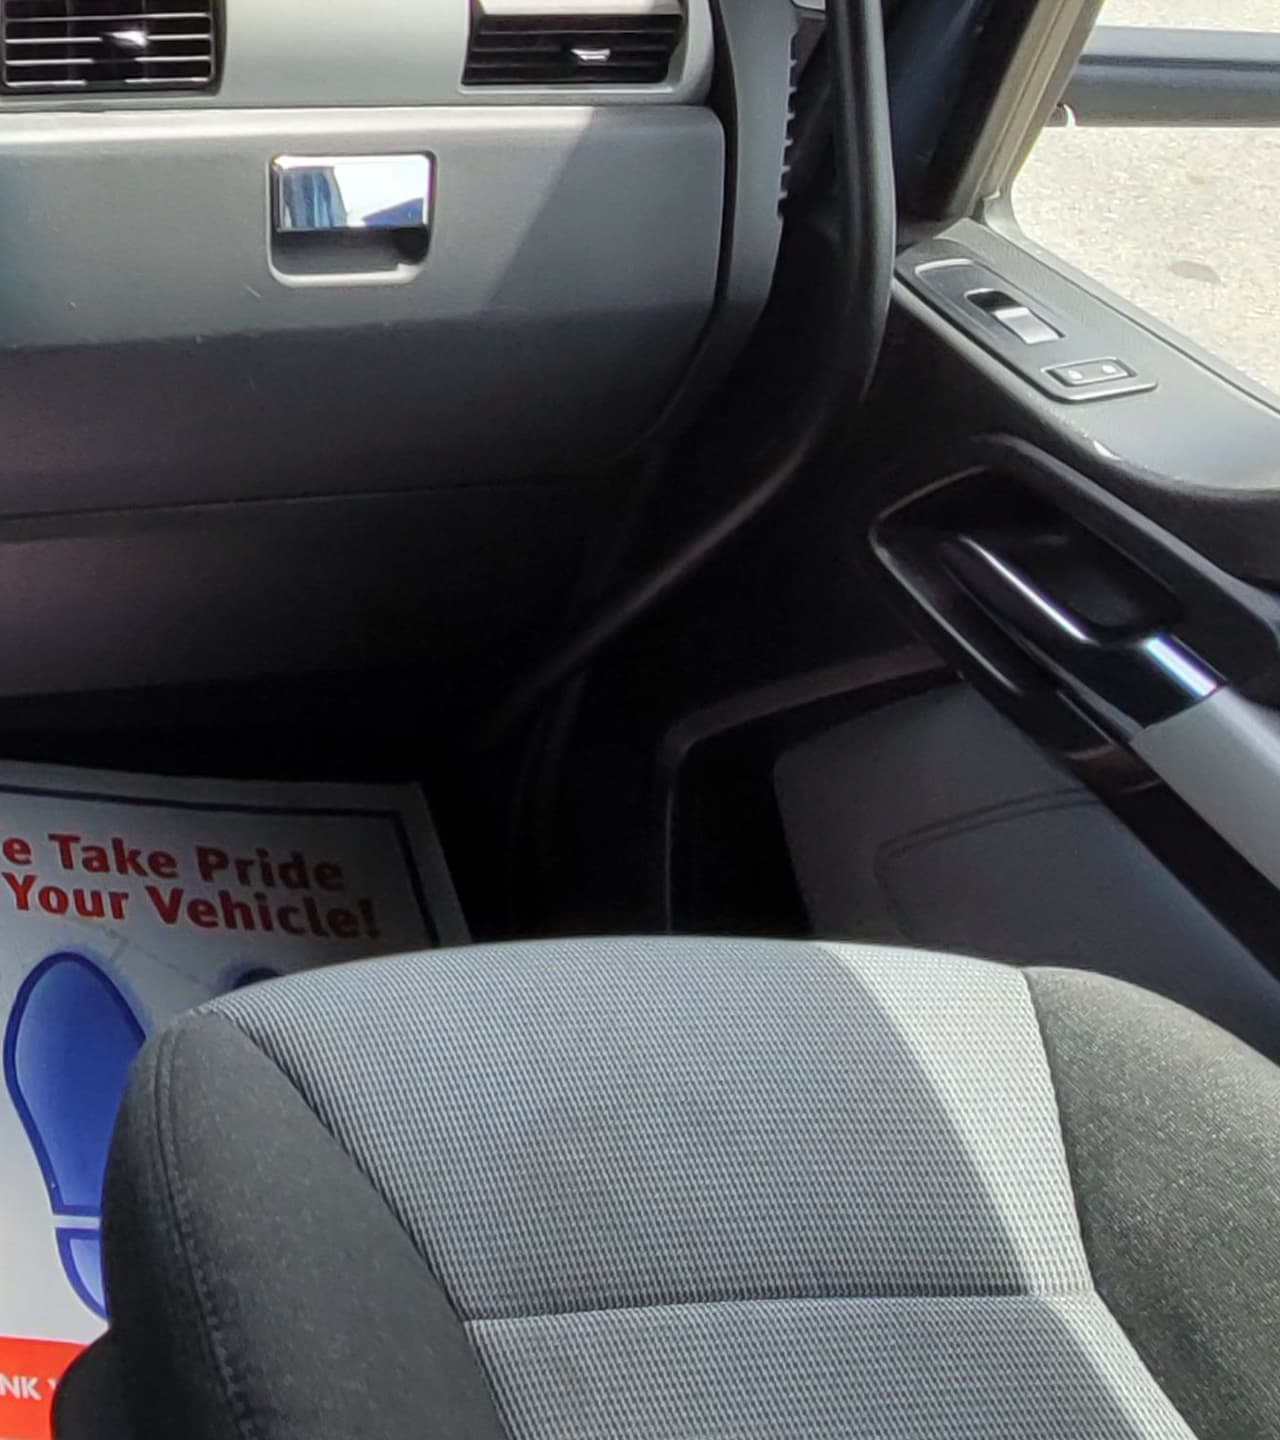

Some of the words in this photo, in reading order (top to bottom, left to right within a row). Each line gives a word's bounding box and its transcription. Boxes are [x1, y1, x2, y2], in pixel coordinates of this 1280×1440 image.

[48, 832, 178, 880] Take
[195, 845, 346, 891] Pride
[1, 871, 129, 921] Your
[145, 884, 382, 939] Vehicle!
